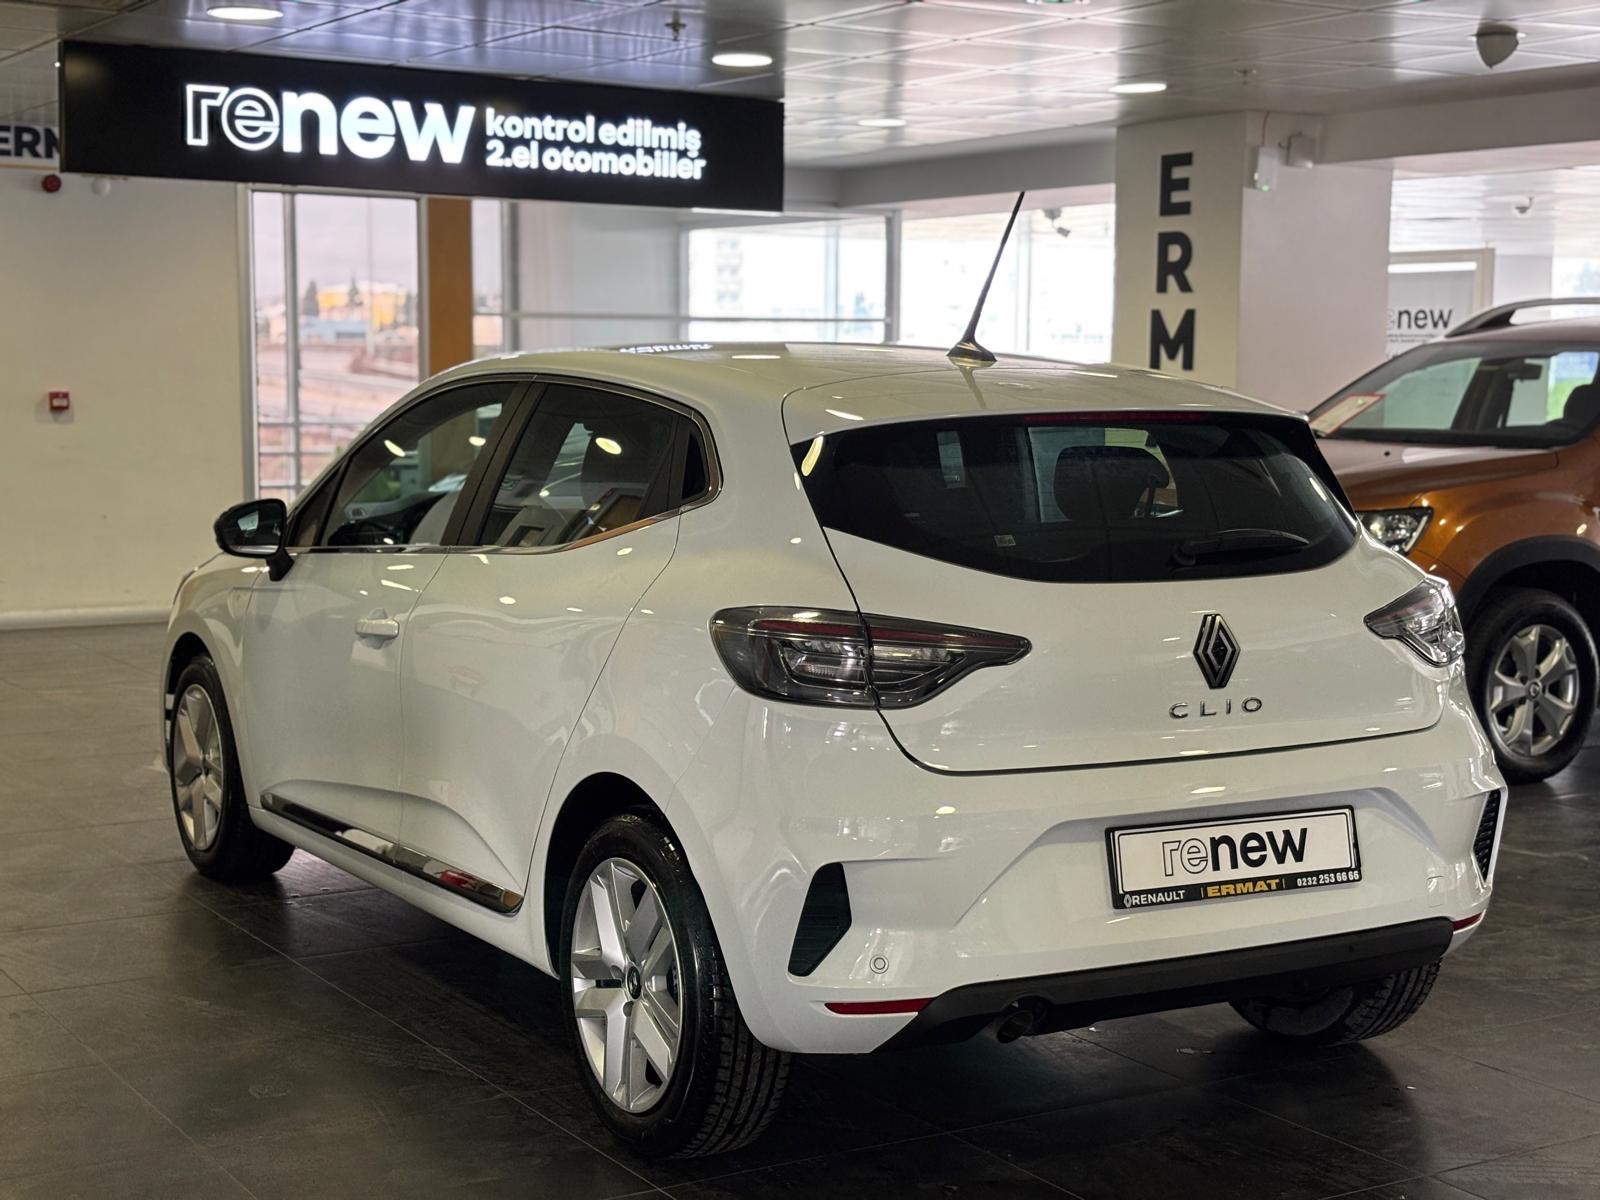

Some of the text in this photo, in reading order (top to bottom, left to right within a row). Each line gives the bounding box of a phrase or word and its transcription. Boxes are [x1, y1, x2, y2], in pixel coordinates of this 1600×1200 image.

[186, 84, 476, 163] renew
[485, 107, 702, 158] kontrol edilmiş
[485, 139, 707, 180] 2.el otomobiller
[1169, 697, 1262, 719] CLIO
[1162, 828, 1308, 877] renew
[1132, 890, 1186, 906] RENAULT
[1206, 879, 1280, 897] ERMAT
[1296, 876, 1318, 887] 0232
[1318, 873, 1336, 884] 253
[1336, 871, 1347, 882] 66
